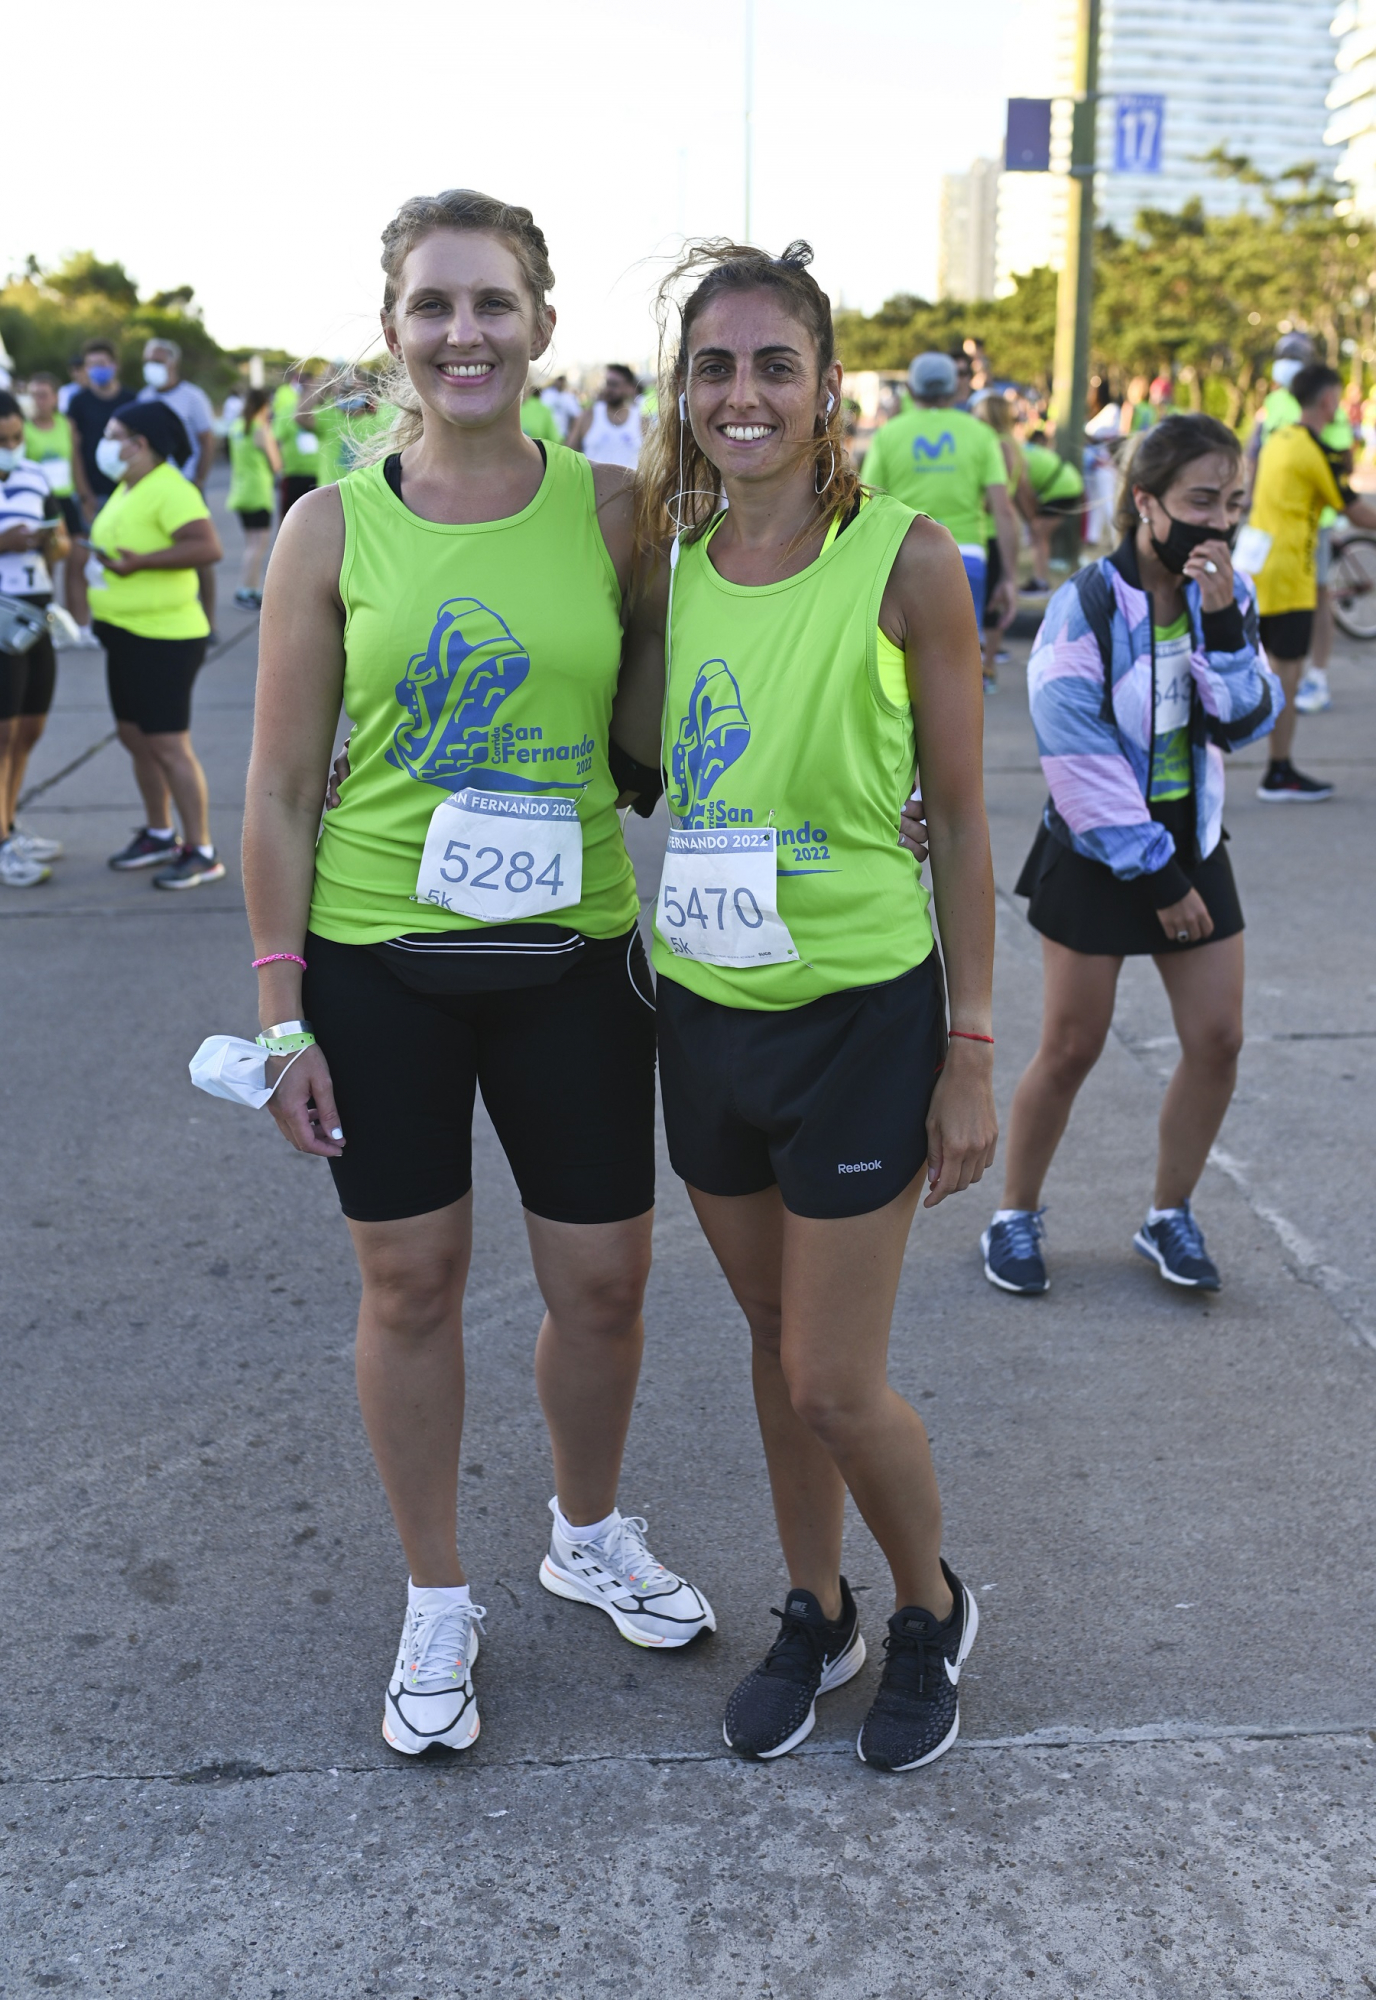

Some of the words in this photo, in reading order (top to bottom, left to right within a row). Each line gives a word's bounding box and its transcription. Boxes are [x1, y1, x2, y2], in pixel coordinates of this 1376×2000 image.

[1121, 110, 1158, 159] 17
[502, 722, 543, 741] San
[491, 726, 501, 764] Corrida
[502, 733, 595, 764] Fernando
[576, 756, 592, 776] 2022
[471, 796, 549, 816] FERNANDO
[715, 799, 754, 823] San
[792, 845, 831, 862] 2022
[439, 839, 564, 896] 5284
[664, 885, 764, 931] 5470
[837, 1159, 882, 1175] Reebok
